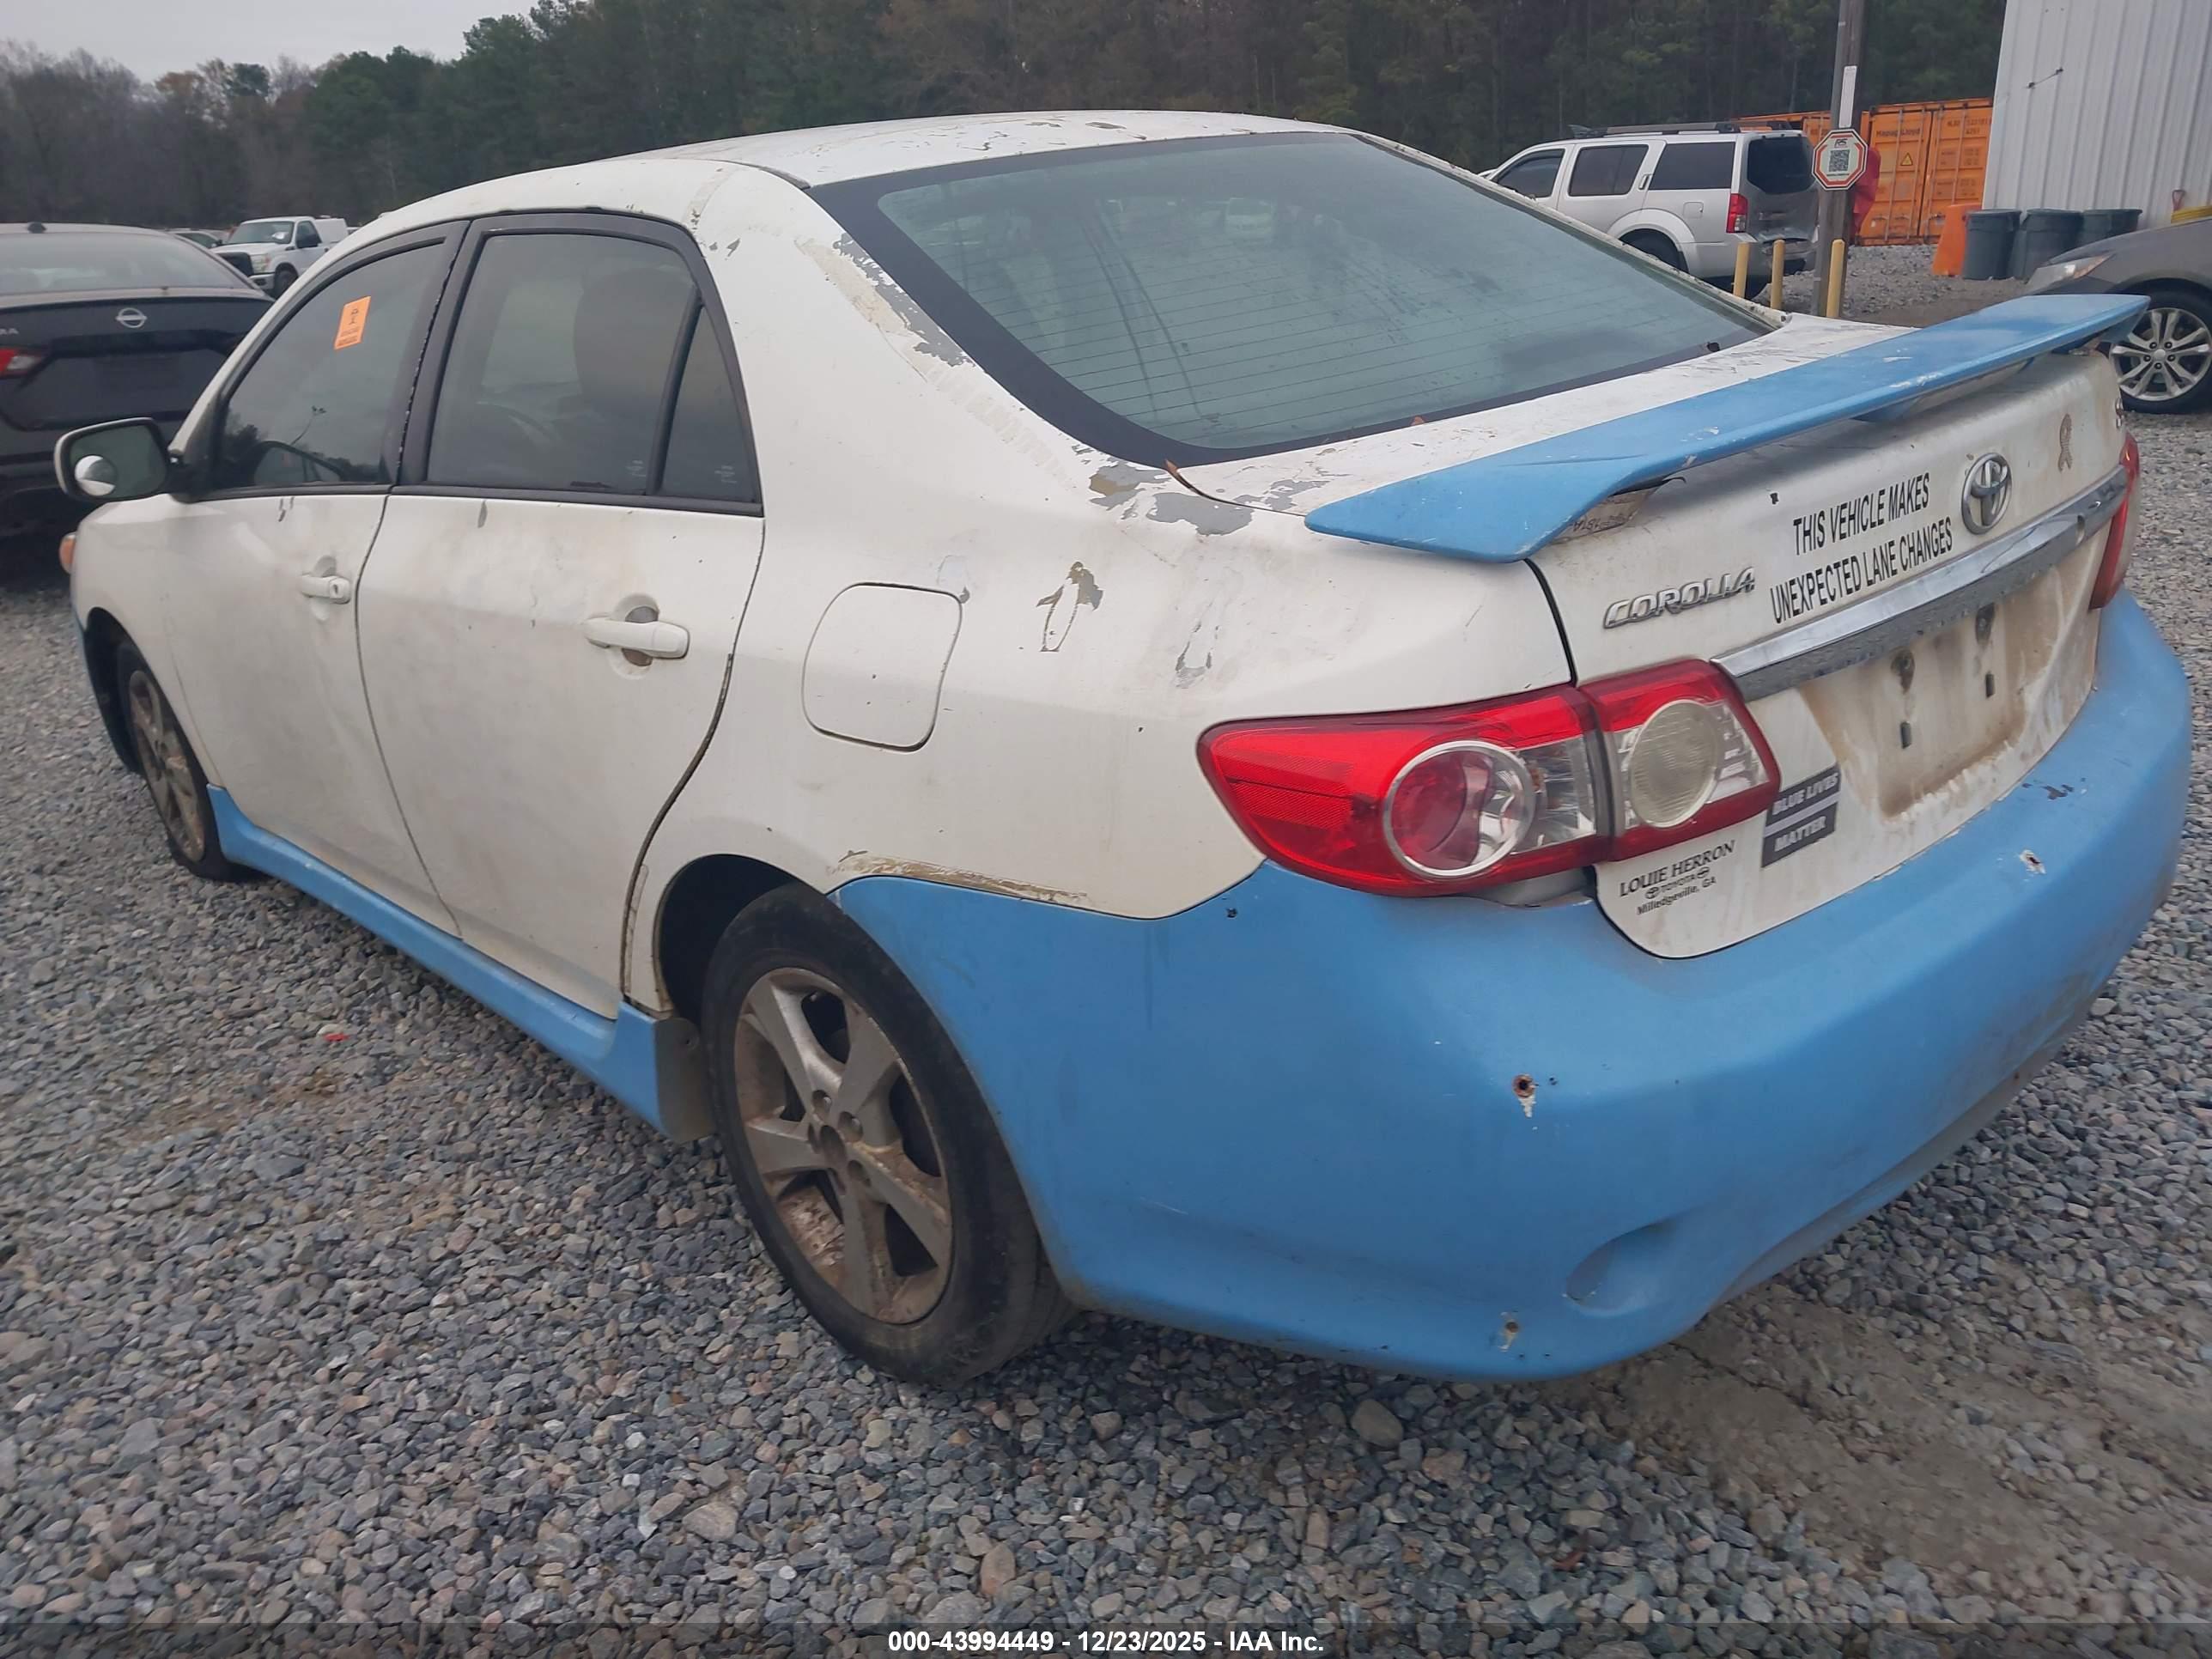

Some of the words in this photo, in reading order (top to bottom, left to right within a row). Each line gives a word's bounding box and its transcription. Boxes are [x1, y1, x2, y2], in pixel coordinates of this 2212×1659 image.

[1793, 509, 1826, 556] THIS
[1830, 489, 1886, 543] VEHICLE
[1888, 472, 1929, 521] MAKES
[1770, 555, 1862, 623] UNEXPECTED
[1863, 539, 1898, 586] LANE
[1899, 516, 1953, 571] CHANGES
[1603, 567, 1755, 629] COROLLA
[1772, 789, 1804, 816] BLUE
[1806, 772, 1838, 799] LIVES
[1774, 816, 1826, 852] MATTER
[1620, 866, 1668, 896] LOUIE
[1670, 840, 1735, 878] HERRON
[1661, 874, 1695, 892] TOYOTA
